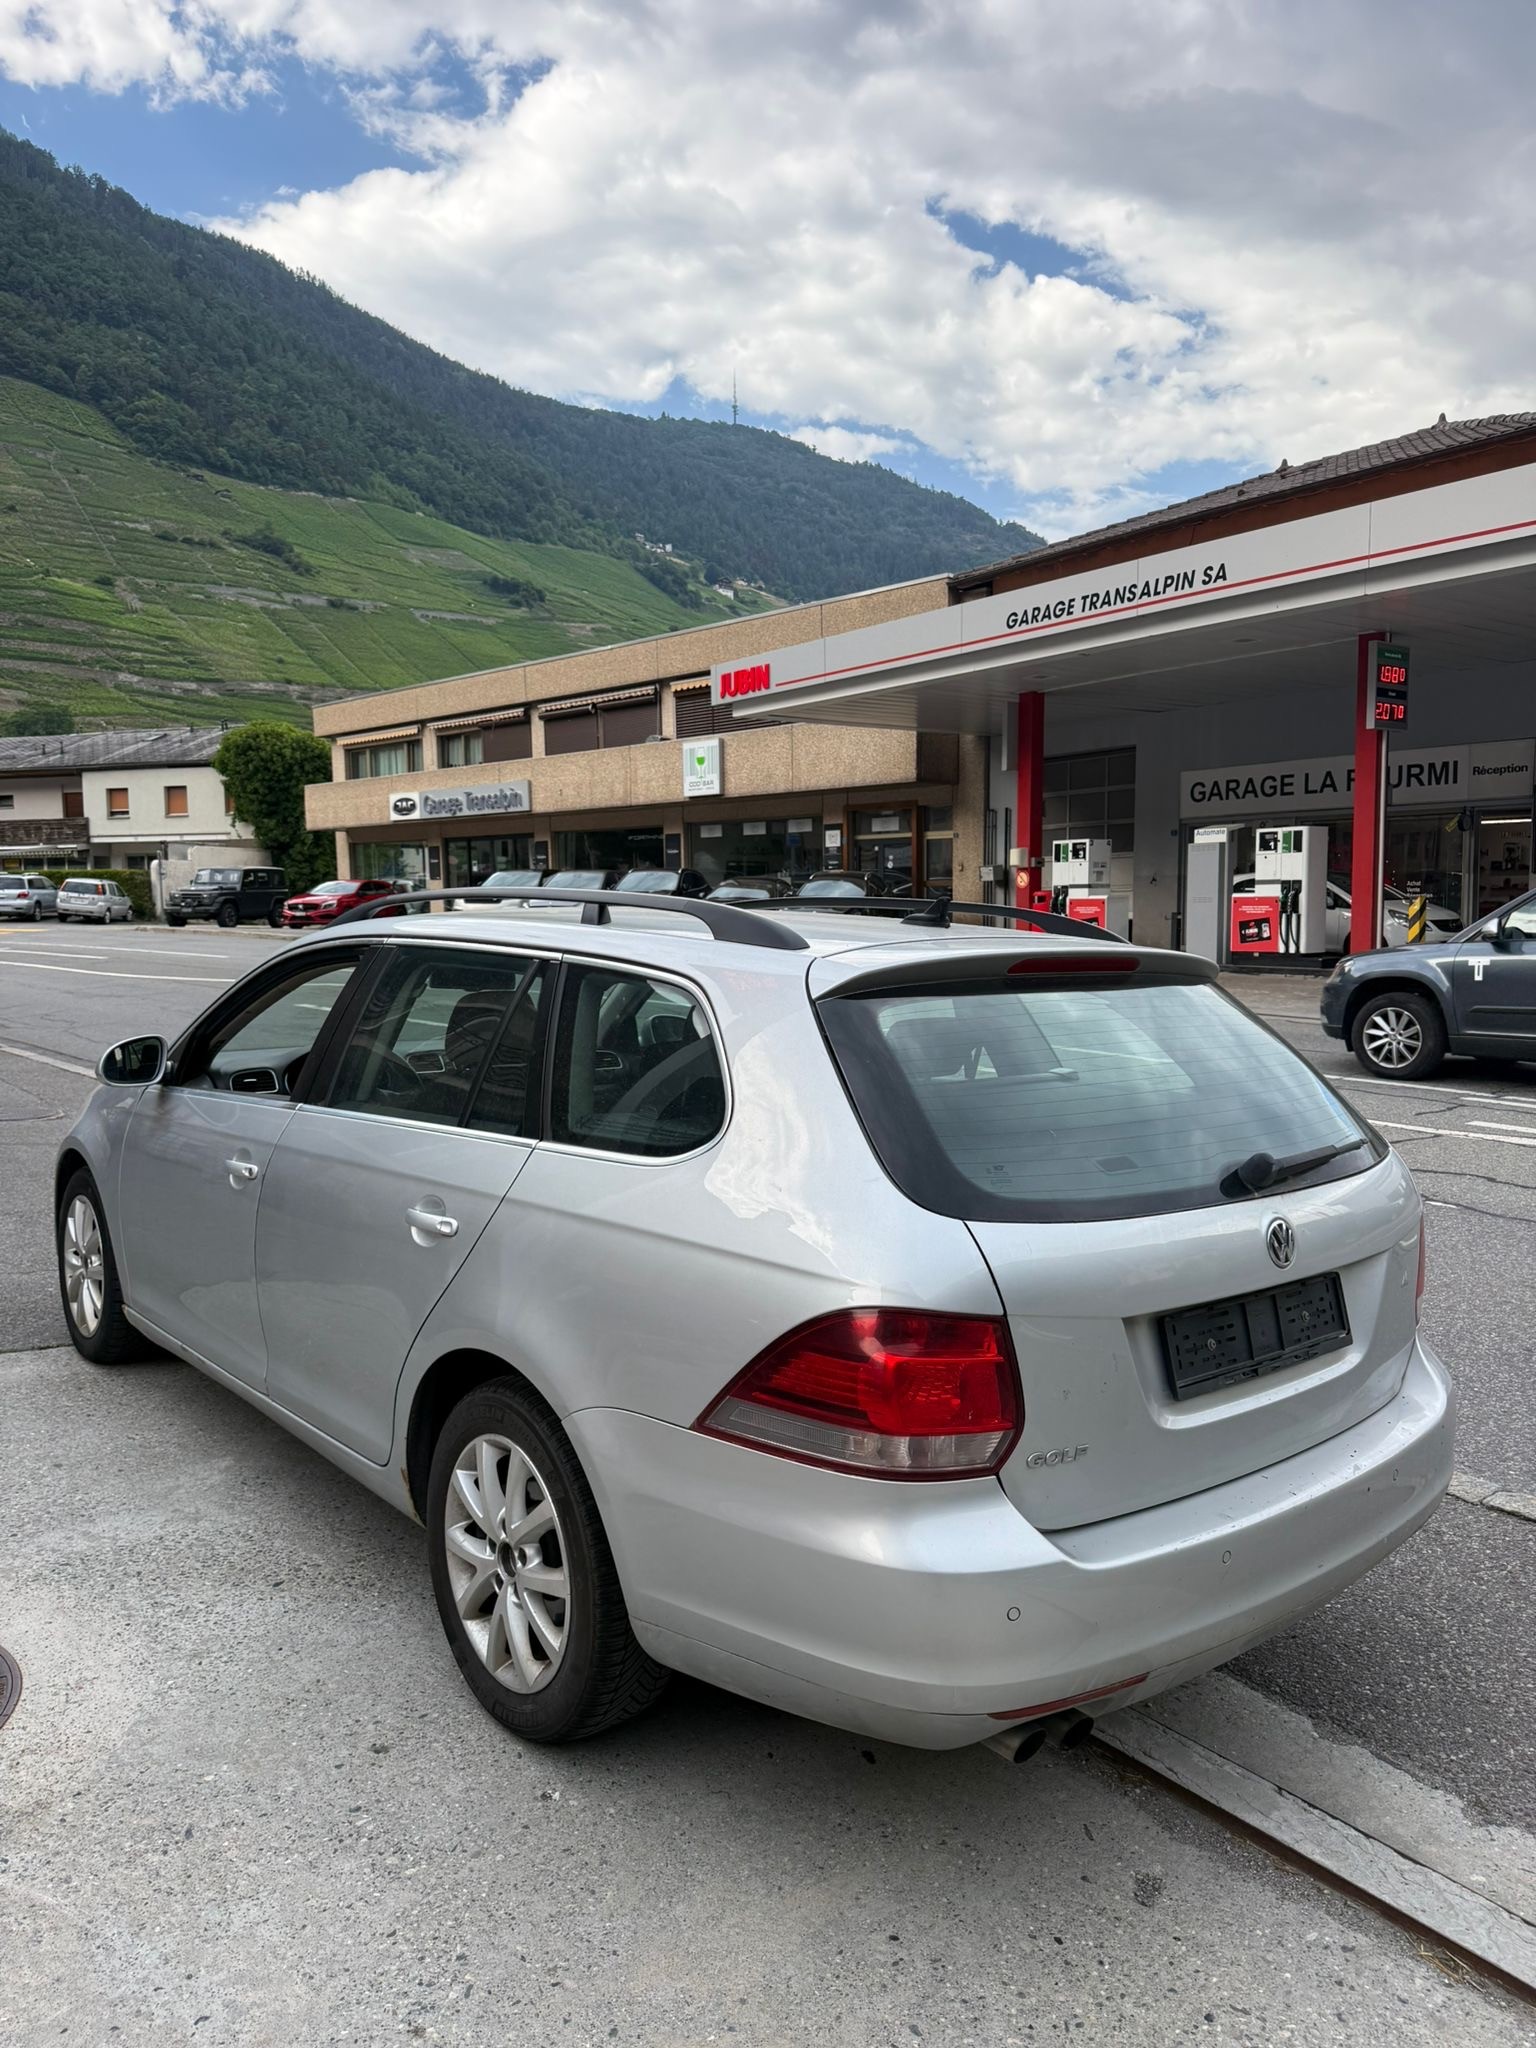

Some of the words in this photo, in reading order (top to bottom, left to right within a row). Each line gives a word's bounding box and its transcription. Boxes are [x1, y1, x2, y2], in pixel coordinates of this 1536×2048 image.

[1006, 598, 1076, 629] GARAGE
[1081, 569, 1196, 613] TRANSALPIN
[1201, 563, 1228, 586] SA
[720, 663, 770, 699] JUBIN
[1190, 774, 1295, 803] GARAGE
[1304, 770, 1338, 795] LA
[1346, 760, 1459, 792] FURMI
[1472, 763, 1529, 776] Réception
[423, 795, 463, 816] Garage
[464, 788, 523, 811] Transalpin
[1026, 1444, 1089, 1469] GOLF
